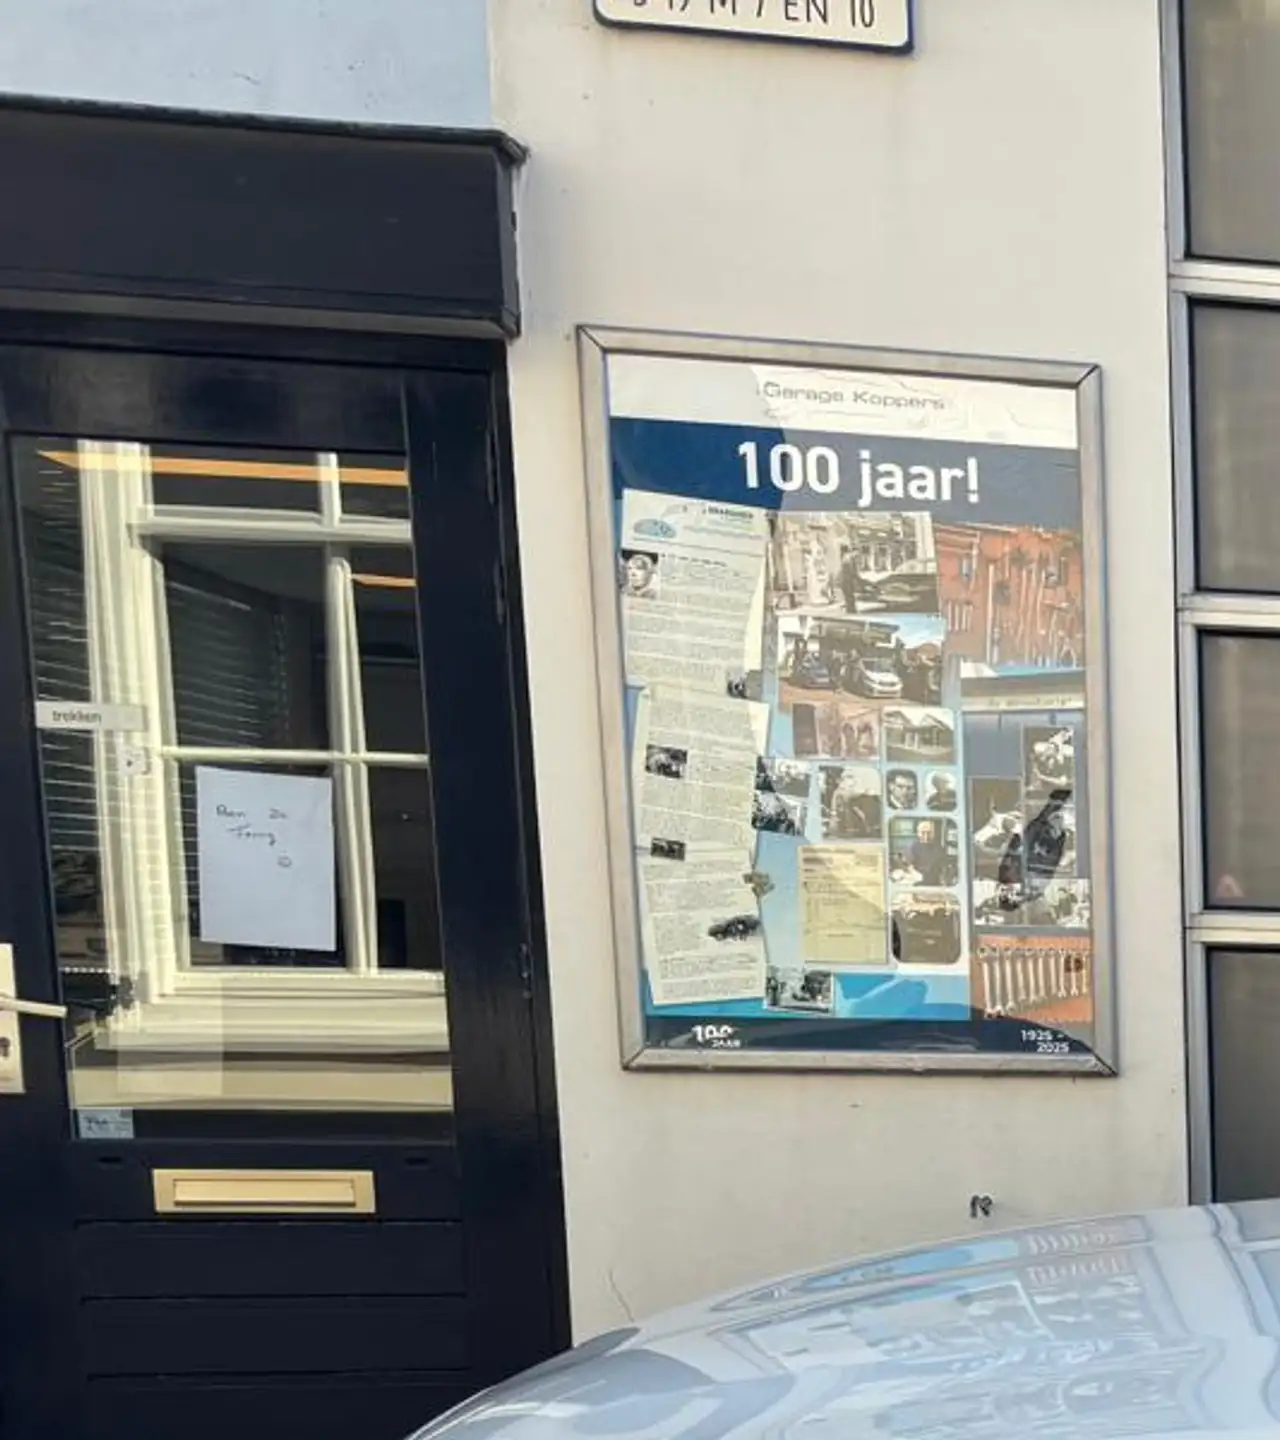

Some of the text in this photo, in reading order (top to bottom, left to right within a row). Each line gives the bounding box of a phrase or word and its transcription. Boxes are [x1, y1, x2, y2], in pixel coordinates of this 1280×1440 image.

[763, 381, 945, 411] Garage Koppers
[738, 441, 980, 508] 100 jaar!
